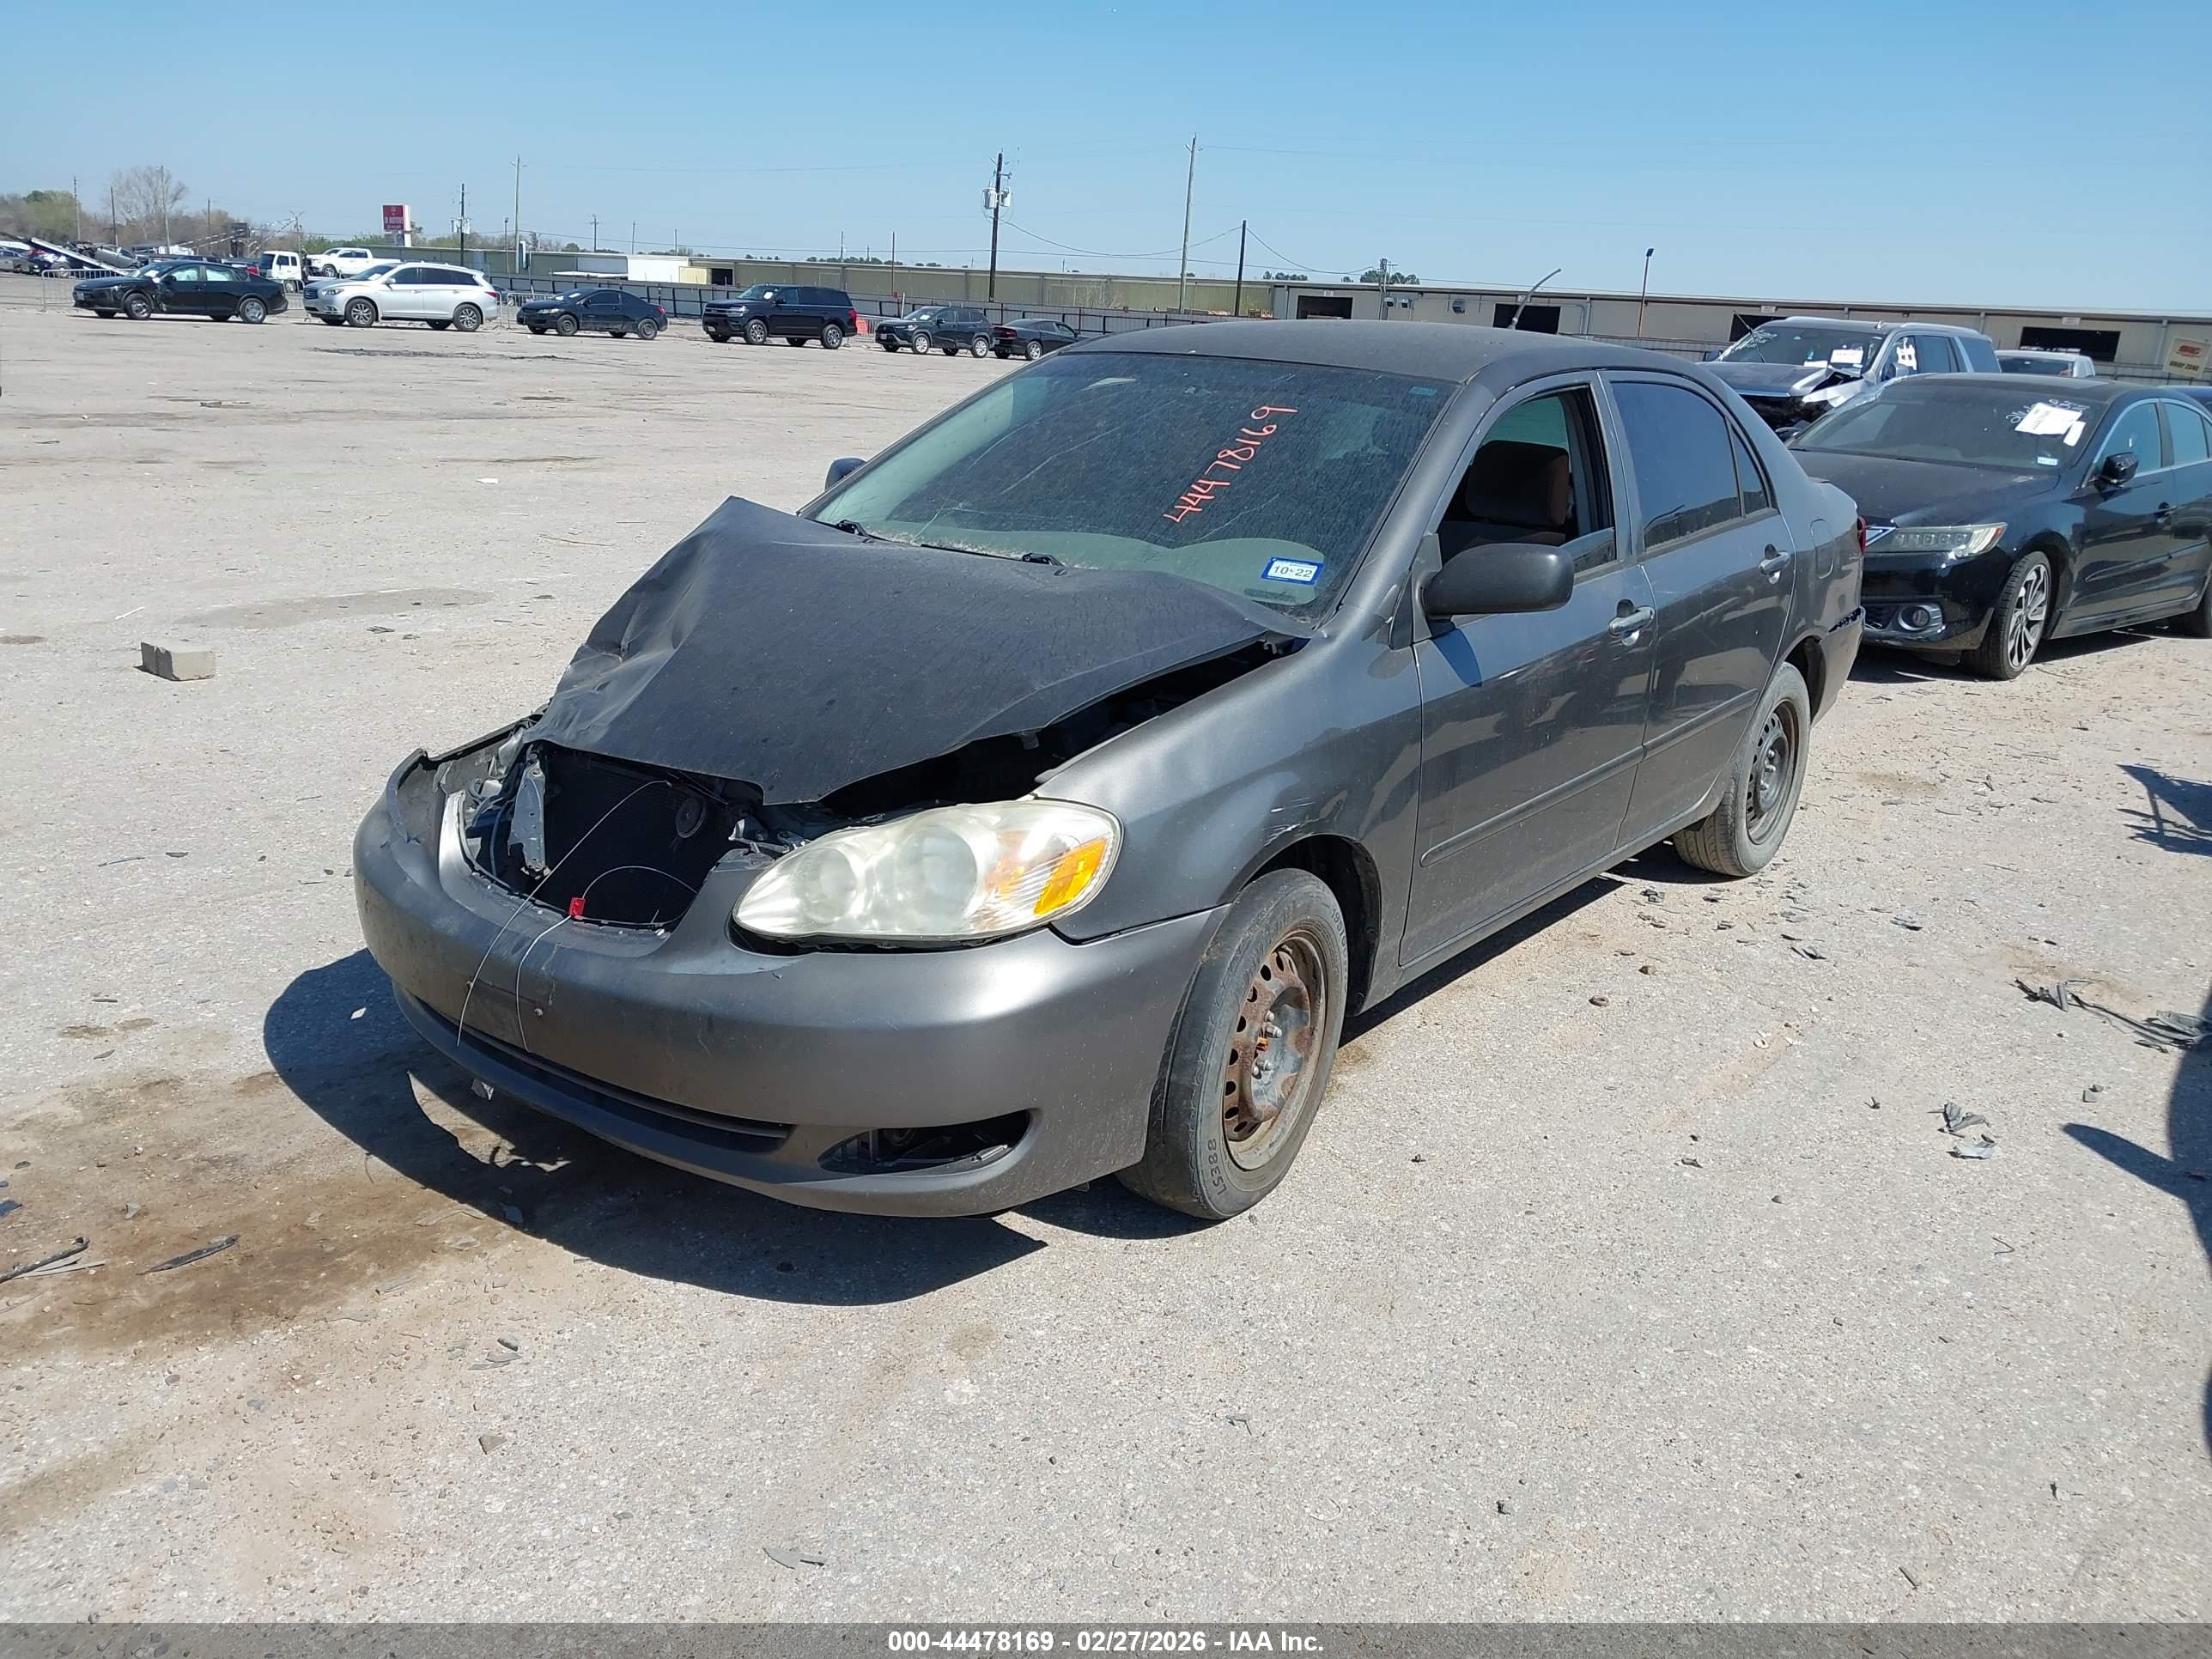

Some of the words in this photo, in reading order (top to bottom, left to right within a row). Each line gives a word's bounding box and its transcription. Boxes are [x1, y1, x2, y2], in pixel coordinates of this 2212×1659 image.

[2185, 363, 2200, 372] ZONE
[1163, 405, 1298, 523] 44478169
[1207, 1138, 1227, 1195] LS388
